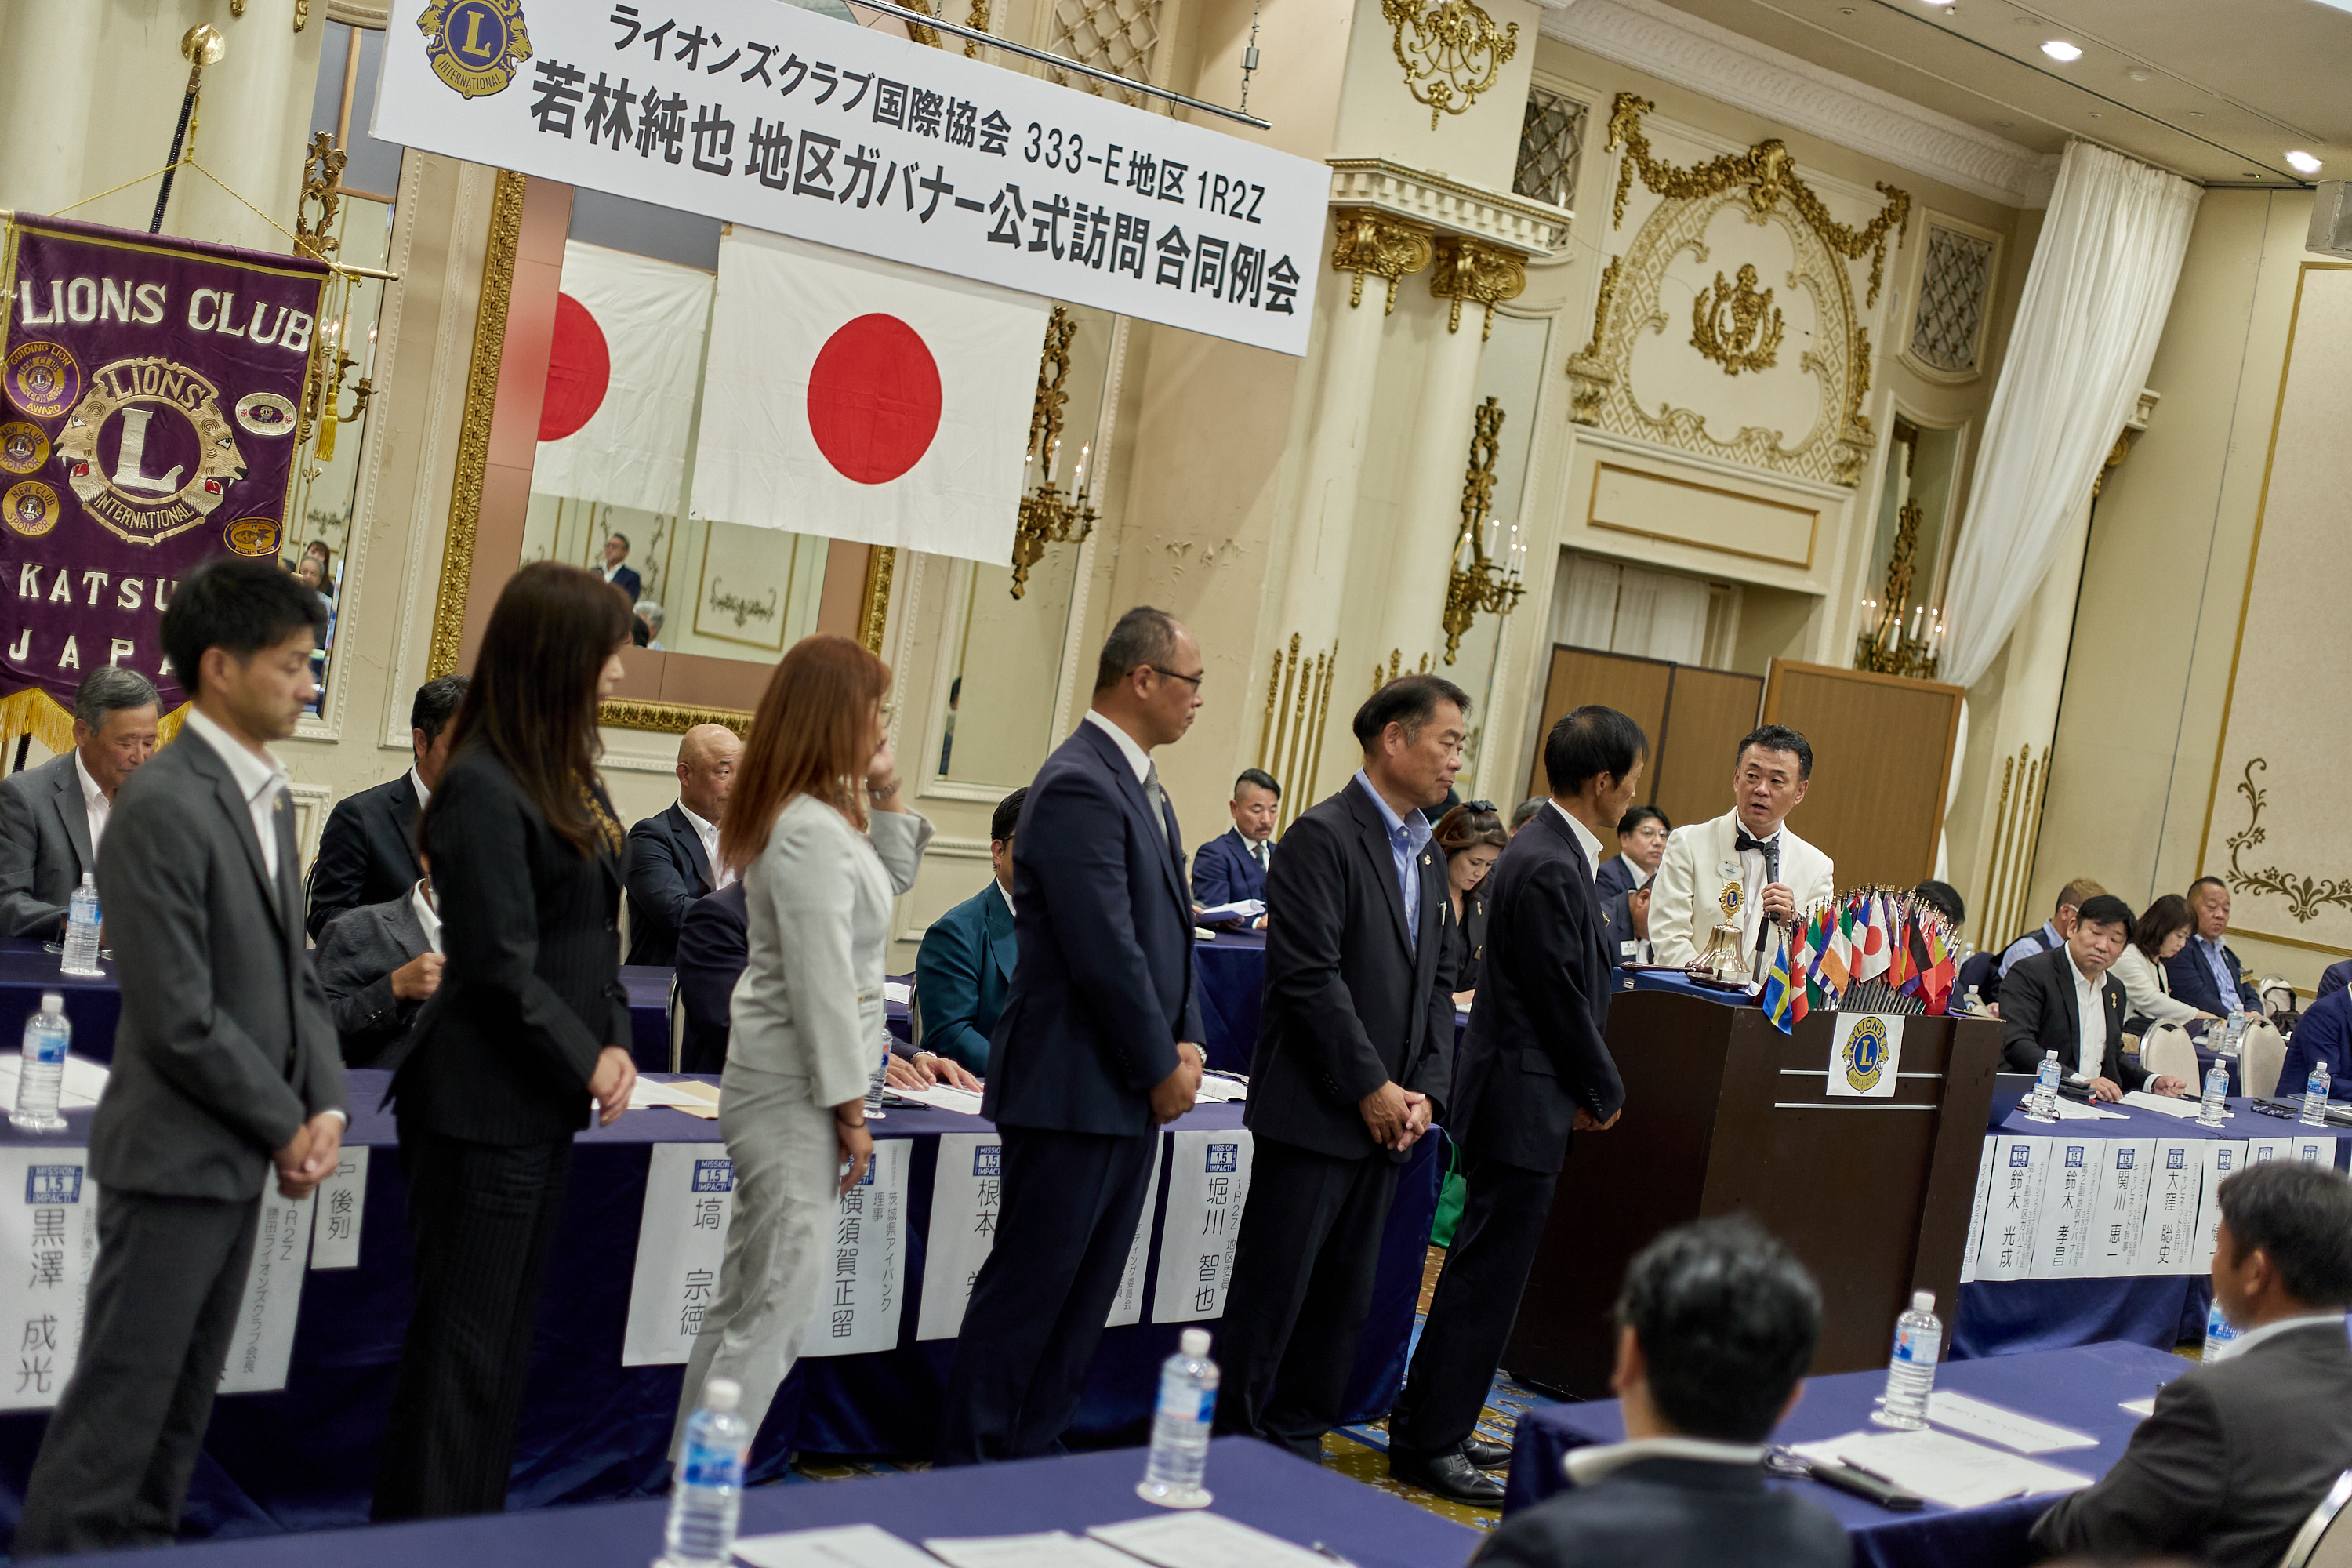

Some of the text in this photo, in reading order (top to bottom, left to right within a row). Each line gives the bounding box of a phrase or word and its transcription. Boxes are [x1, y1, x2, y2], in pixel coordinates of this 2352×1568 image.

[462, 10, 491, 57] L
[438, 60, 503, 89] INTERNATIONAL
[530, 59, 735, 176] 若林純也
[610, 4, 1265, 223] ライオンズクラブ国際協会 333-E地区 1R2Z
[20, 278, 314, 352] LIONS CLUB
[11, 345, 71, 366] GUIDING LION
[18, 357, 60, 376] NEW CLUB
[24, 385, 64, 403] SPONSOR
[108, 365, 206, 408] LIONS
[26, 402, 61, 415] AWARD
[23, 426, 45, 445] CLUB
[112, 406, 184, 493] L
[11, 485, 56, 506] NEW CLUB
[94, 492, 194, 529] INTERNATIONAL
[7, 512, 49, 533] SPONSOR
[1857, 1020, 1884, 1035] LIONS
[1860, 1040, 1872, 1065] L
[1850, 1073, 1877, 1087] INTERNATIONAL
[36, 1167, 75, 1176] MISSION
[707, 1169, 721, 1181] 1.5
[985, 1156, 997, 1167] 1.5
[1216, 1152, 1228, 1164] 1.5
[33, 1192, 72, 1203] IMPACT!
[45, 1177, 64, 1191] 1.5
[2165, 1171, 2179, 1211] 大窪
[328, 1189, 353, 1240] 後列
[693, 1197, 723, 1229] 塙
[872, 1192, 885, 1222] 理事
[975, 1179, 1000, 1237] 根本
[1999, 1169, 2024, 1268] 鈴木 光成
[2053, 1170, 2078, 1266] 鈴木 孝昌
[2107, 1171, 2129, 1257] 関川 恵一
[1195, 1178, 1229, 1312] 堀川 智也
[1221, 1178, 1242, 1291] 1R2Z 地区委員
[2157, 1224, 2173, 1265] 聡史
[832, 1186, 864, 1338] 横須賀正留
[881, 1192, 898, 1312] 茨城県アイバンク
[15, 1208, 65, 1394] 黒澤 成光
